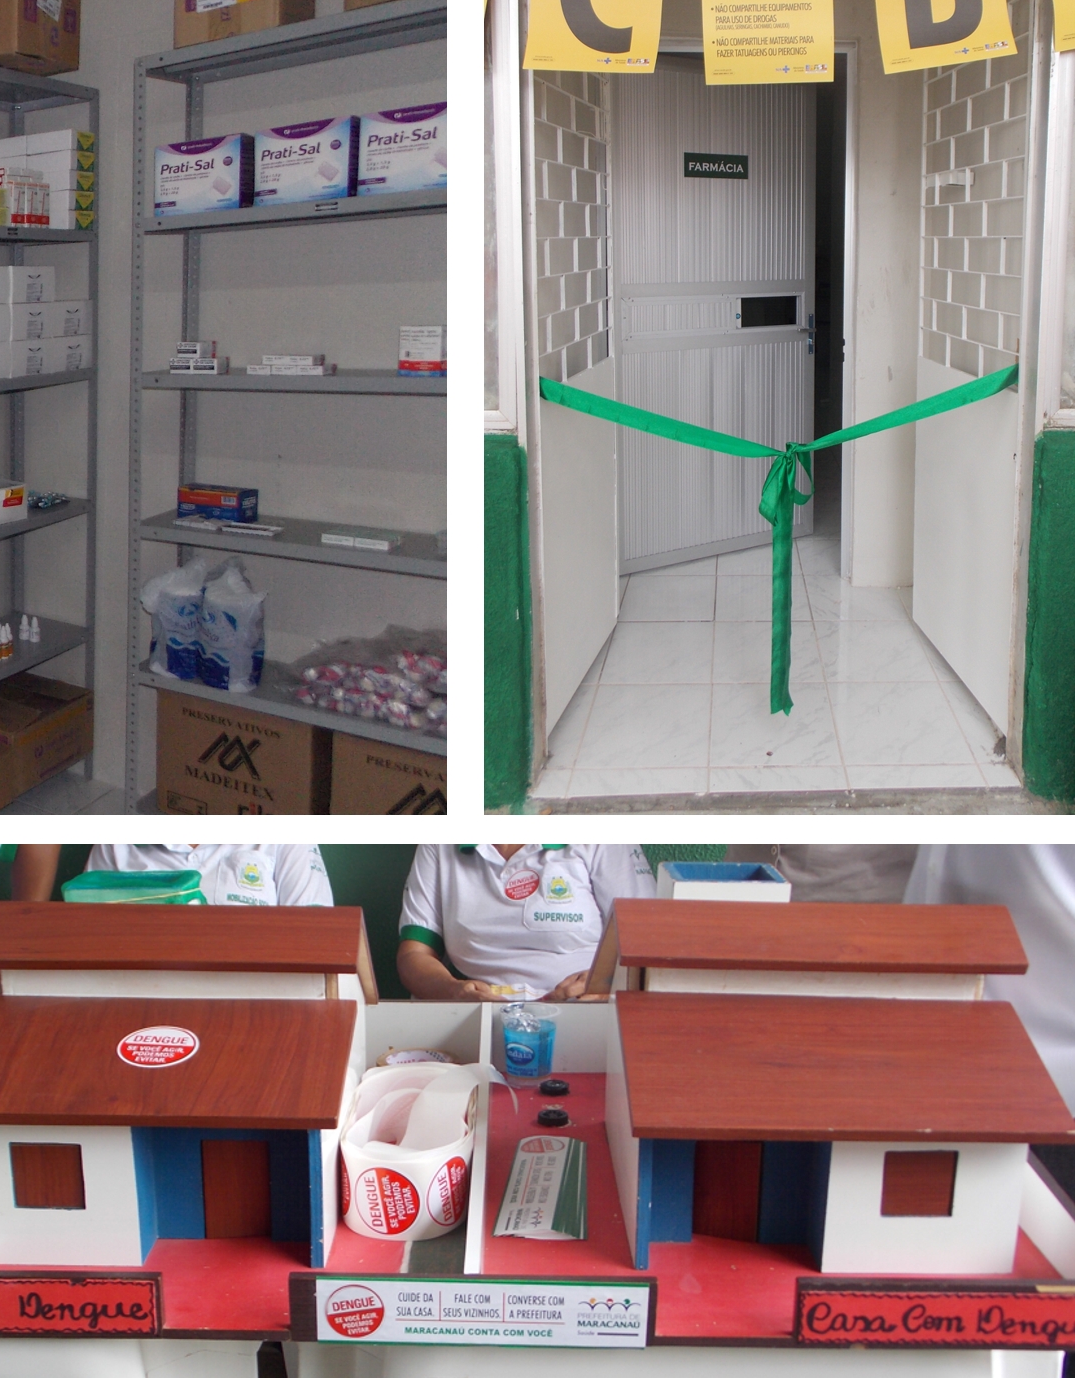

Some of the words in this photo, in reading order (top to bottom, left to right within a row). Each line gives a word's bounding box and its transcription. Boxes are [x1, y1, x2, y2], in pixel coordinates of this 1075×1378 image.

[715, 3, 728, 13] NÃO
[729, 4, 767, 12] COMPARTILHE
[769, 3, 812, 12] EQUIPAMENTOS
[716, 16, 730, 24] PARA
[745, 15, 752, 23] DE
[753, 15, 777, 23] DROGAS
[367, 126, 438, 147] Prati-Sal
[261, 142, 321, 162] Prati-Sal
[160, 158, 214, 176] Prati-Sal
[689, 161, 743, 172] FARMÁCIA
[181, 707, 281, 740] PRESERVATIVOS
[184, 764, 275, 802] MADEITEX
[533, 911, 583, 923] SUPERVISOR
[133, 1035, 189, 1044] DENGUE
[364, 1176, 383, 1227] DENGUE
[392, 1182, 406, 1220] PODEMOS
[437, 1172, 453, 1222] DENGUE
[384, 1198, 396, 1219] VOCÊ
[389, 1220, 399, 1228] SE
[332, 1296, 375, 1311] DENGUE
[398, 1292, 420, 1303] CUIDE
[422, 1293, 434, 1303] DA
[454, 1293, 472, 1304] FALE
[473, 1294, 491, 1304] COM
[507, 1295, 545, 1306] CONVERSE
[547, 1295, 565, 1306] COM
[18, 1292, 148, 1329] Dengue
[396, 1306, 411, 1317] SUA
[413, 1306, 435, 1318] CASA.
[443, 1307, 462, 1318] SEUS
[464, 1307, 501, 1319] VIZINHOS.
[509, 1310, 514, 1319] A
[516, 1309, 562, 1320] PREFEITURA
[577, 1312, 623, 1320] PREFEITURA
[577, 1319, 641, 1329] MARACANAÚ
[807, 1302, 897, 1334] Casa
[902, 1303, 965, 1333] Com
[342, 1320, 374, 1329] PODEMOS
[405, 1325, 465, 1335] MARACANAÚ
[468, 1327, 500, 1336] CONTA
[502, 1328, 525, 1337] COM
[527, 1328, 553, 1337] VOCÊ
